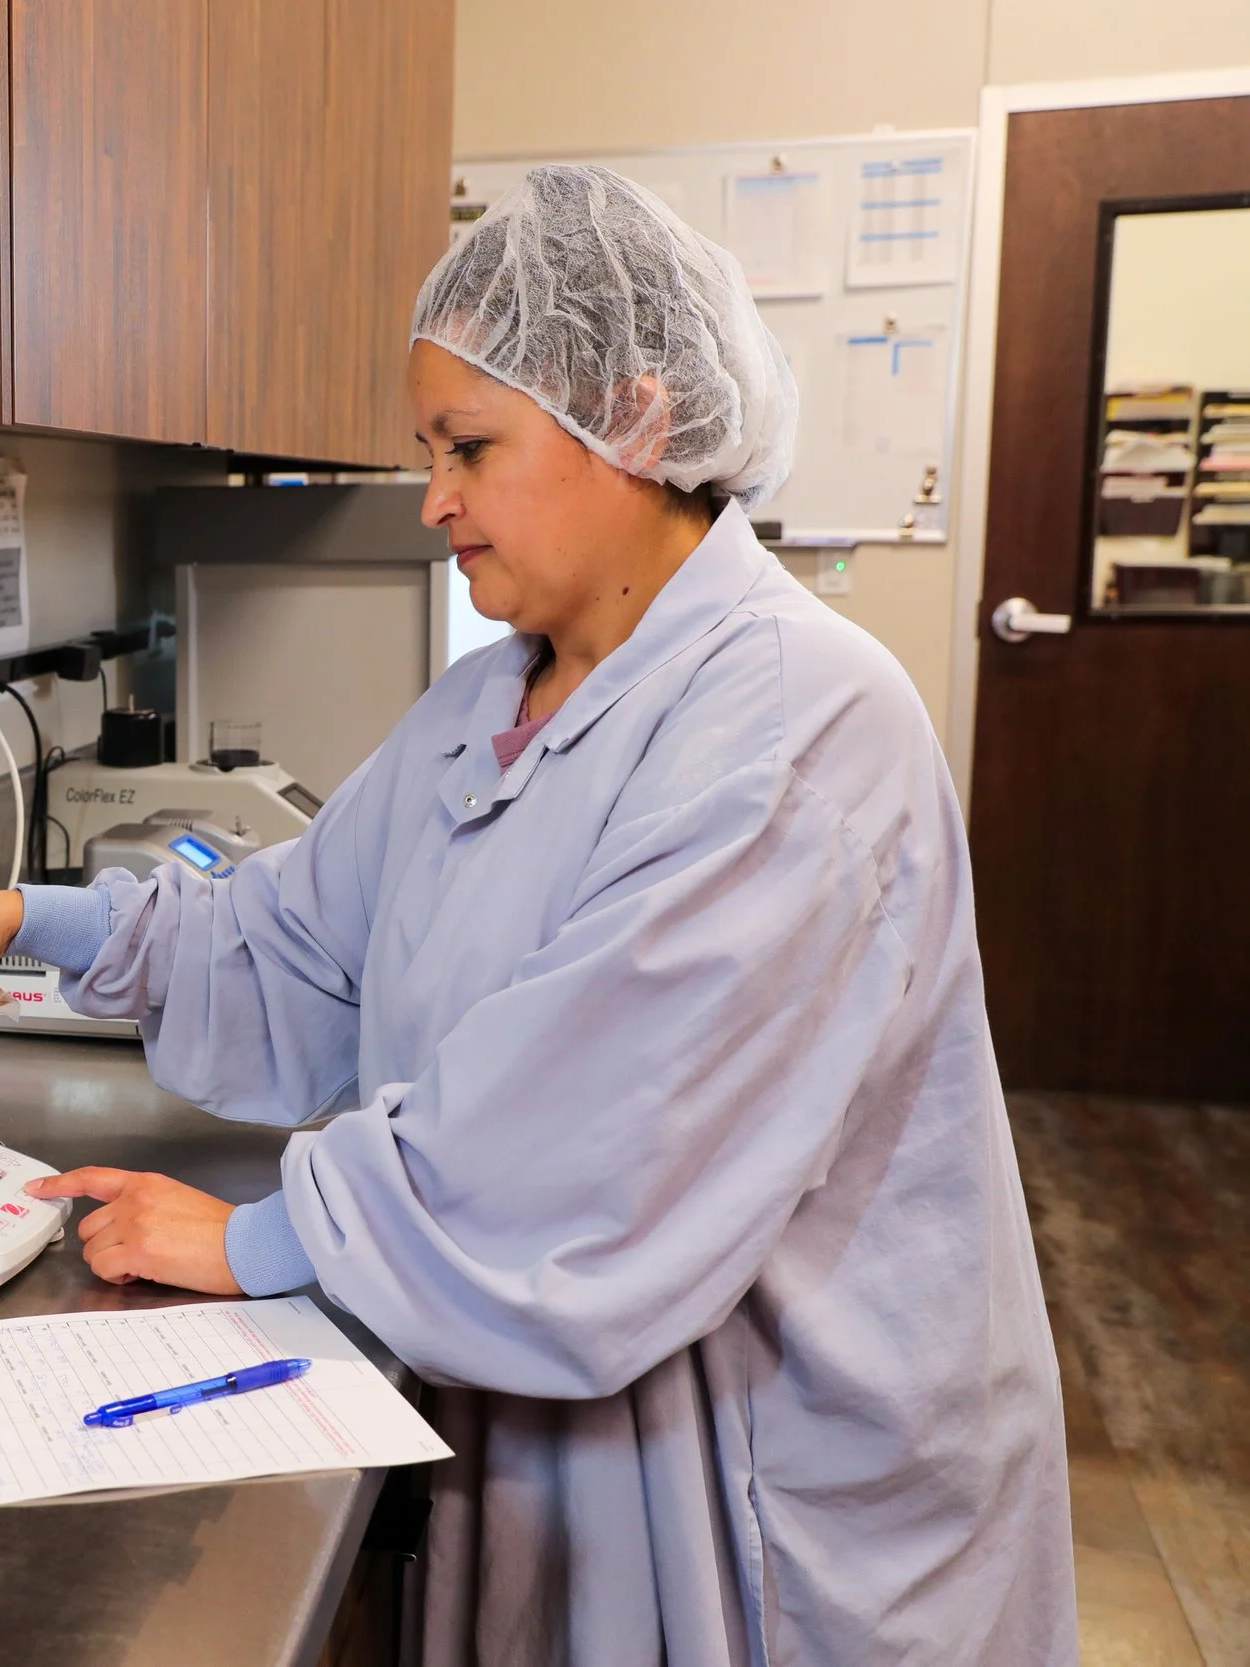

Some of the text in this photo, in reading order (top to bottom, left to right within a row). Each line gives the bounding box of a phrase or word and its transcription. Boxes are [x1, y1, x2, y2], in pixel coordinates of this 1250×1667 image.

[66, 787, 136, 804] ColorFlex EZ
[12, 991, 43, 1002] AUS
